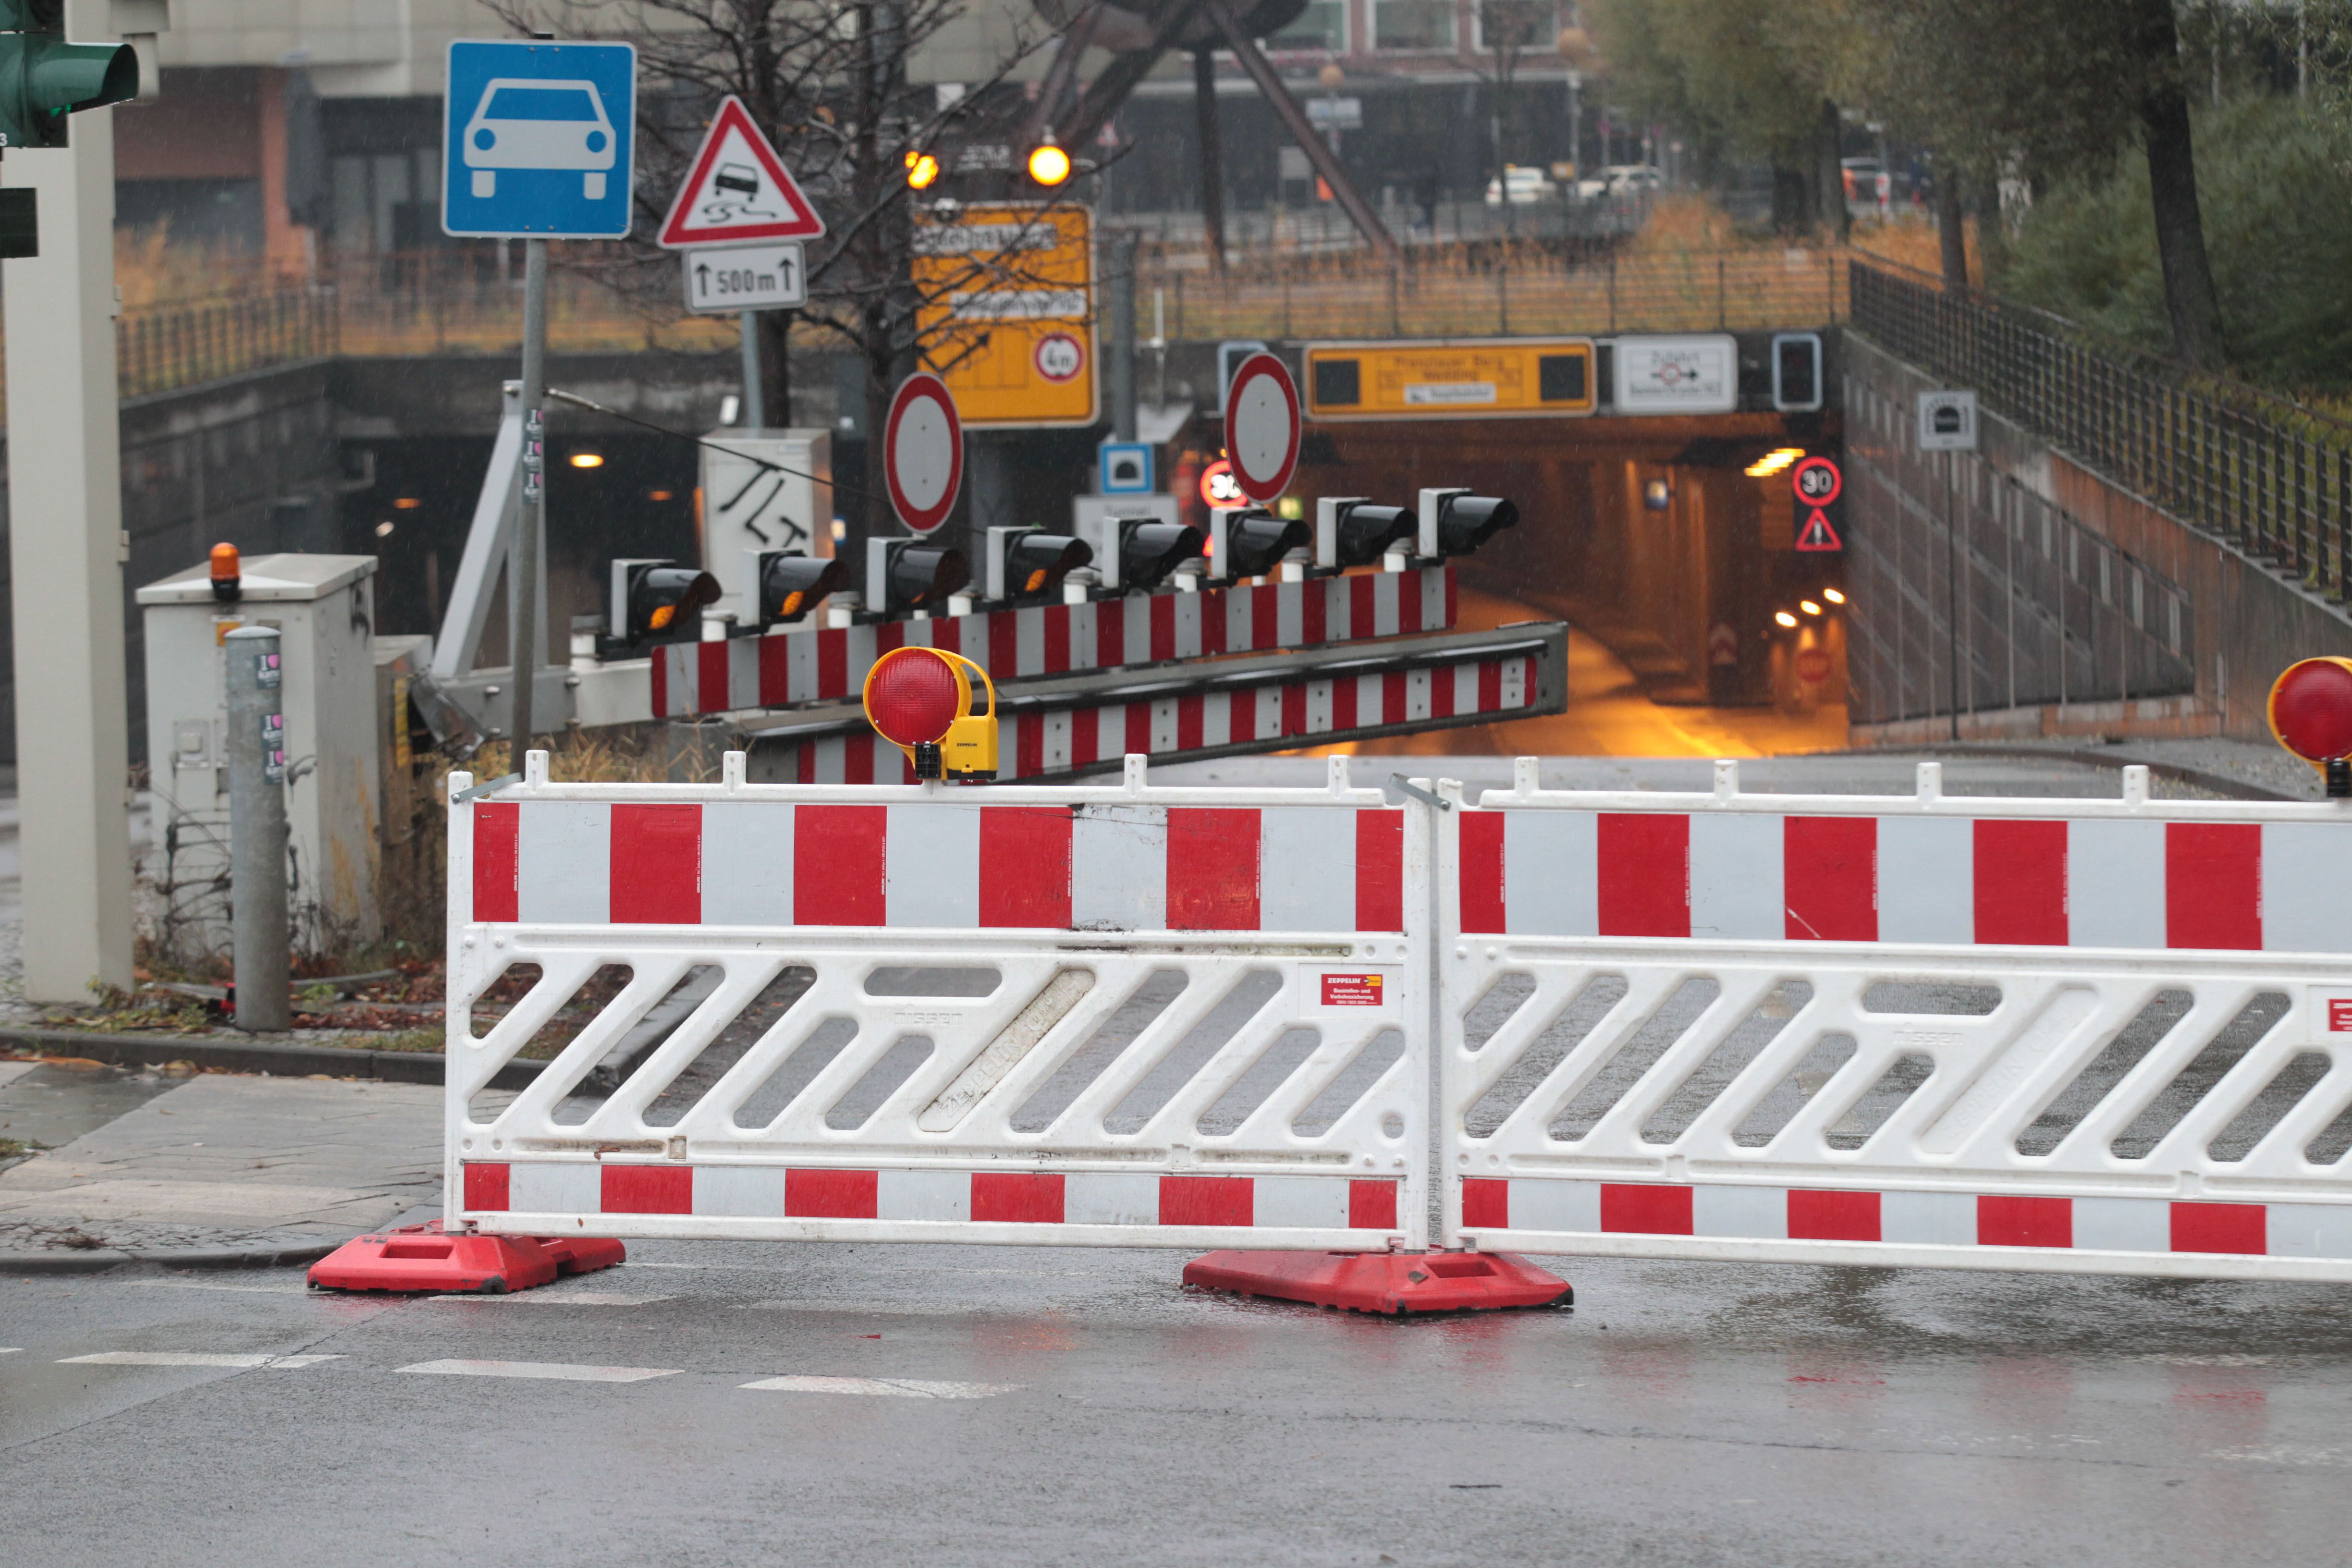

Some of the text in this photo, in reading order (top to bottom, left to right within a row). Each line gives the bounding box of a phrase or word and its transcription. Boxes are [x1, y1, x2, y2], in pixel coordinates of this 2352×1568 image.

[1802, 469, 1833, 494] 30
[894, 1004, 963, 1027] nissen
[1892, 1022, 1964, 1047] nissen
[940, 1039, 1021, 1118] ZEPPELIN
